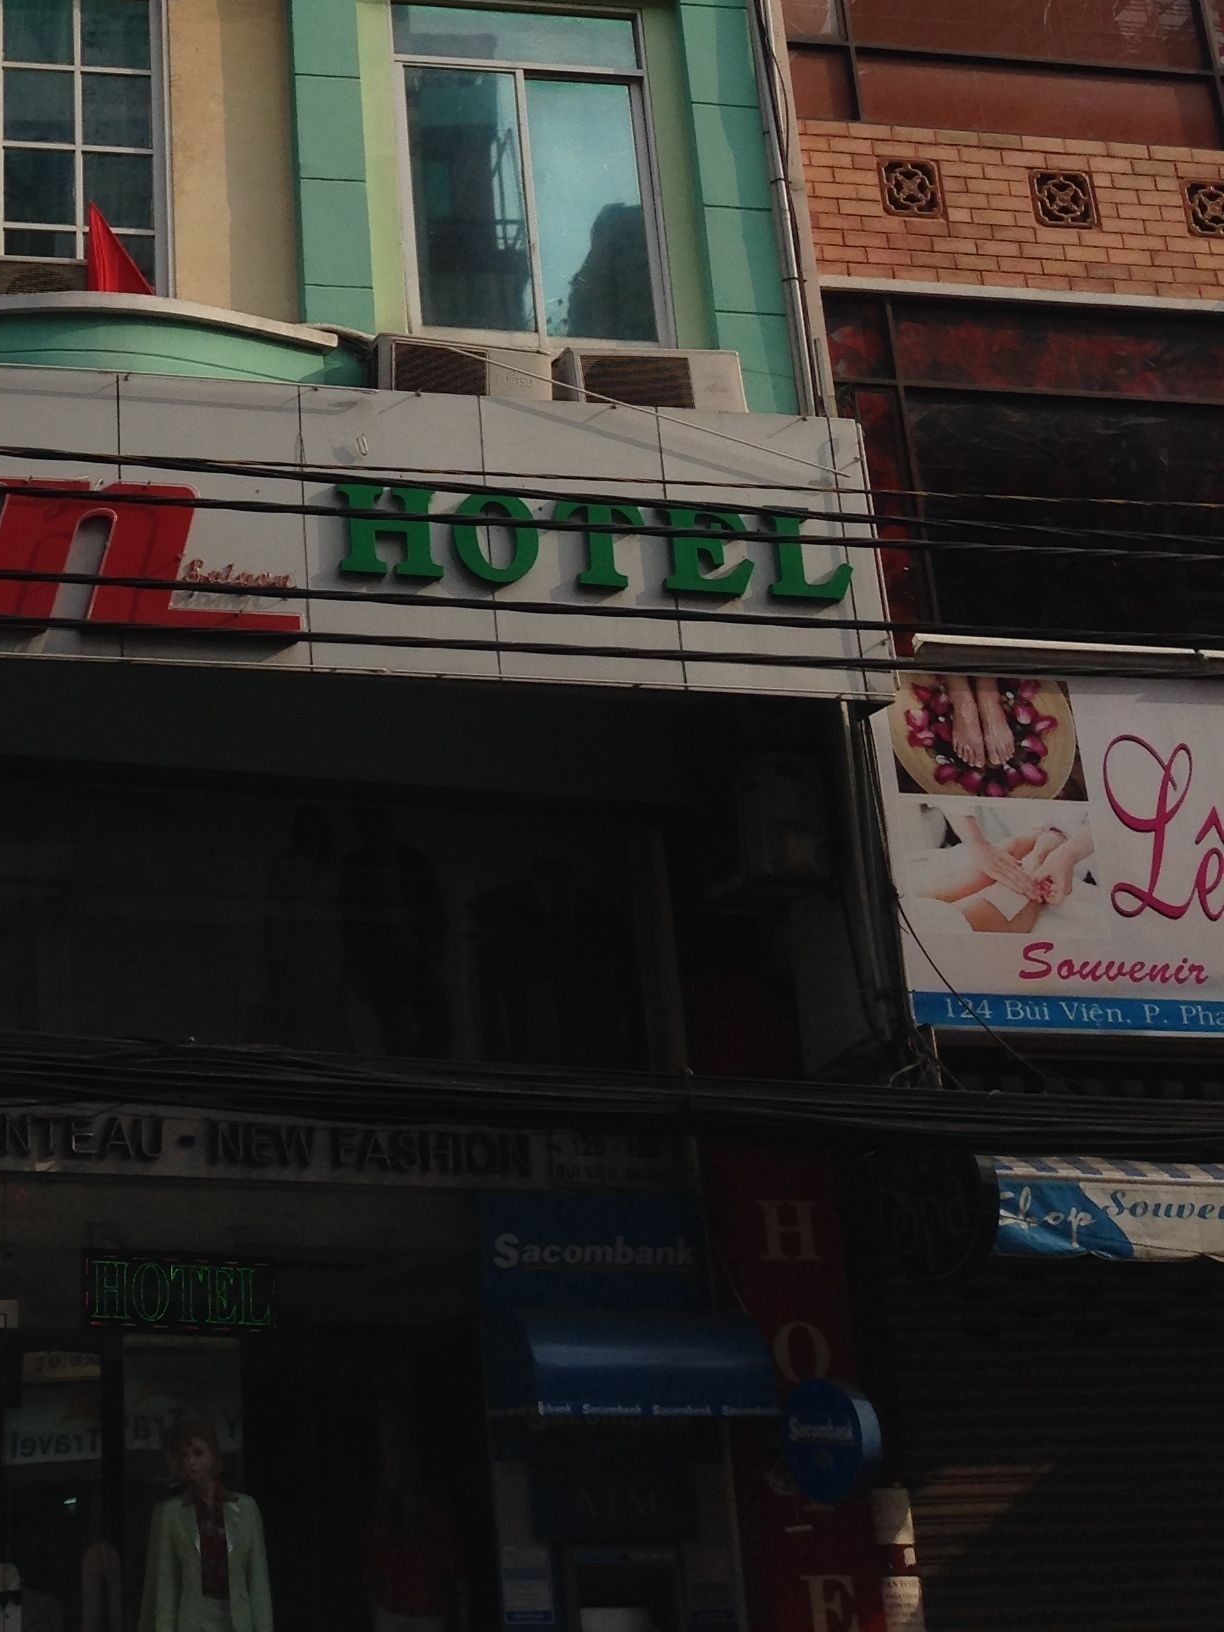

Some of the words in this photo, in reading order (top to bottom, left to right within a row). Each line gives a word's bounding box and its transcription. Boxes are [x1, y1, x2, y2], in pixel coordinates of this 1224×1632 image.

[335, 484, 854, 604] HOTEL
[1018, 941, 1209, 985] Souvenir
[944, 997, 993, 1019] 124
[1004, 999, 1051, 1021] Bùi
[1141, 1004, 1168, 1024] P.
[212, 1120, 316, 1166] NEW
[332, 1128, 533, 1176] FASHION
[1103, 1188, 1224, 1222] Souve
[493, 1232, 695, 1269] Sacombank
[89, 1259, 273, 1328] HOTEL
